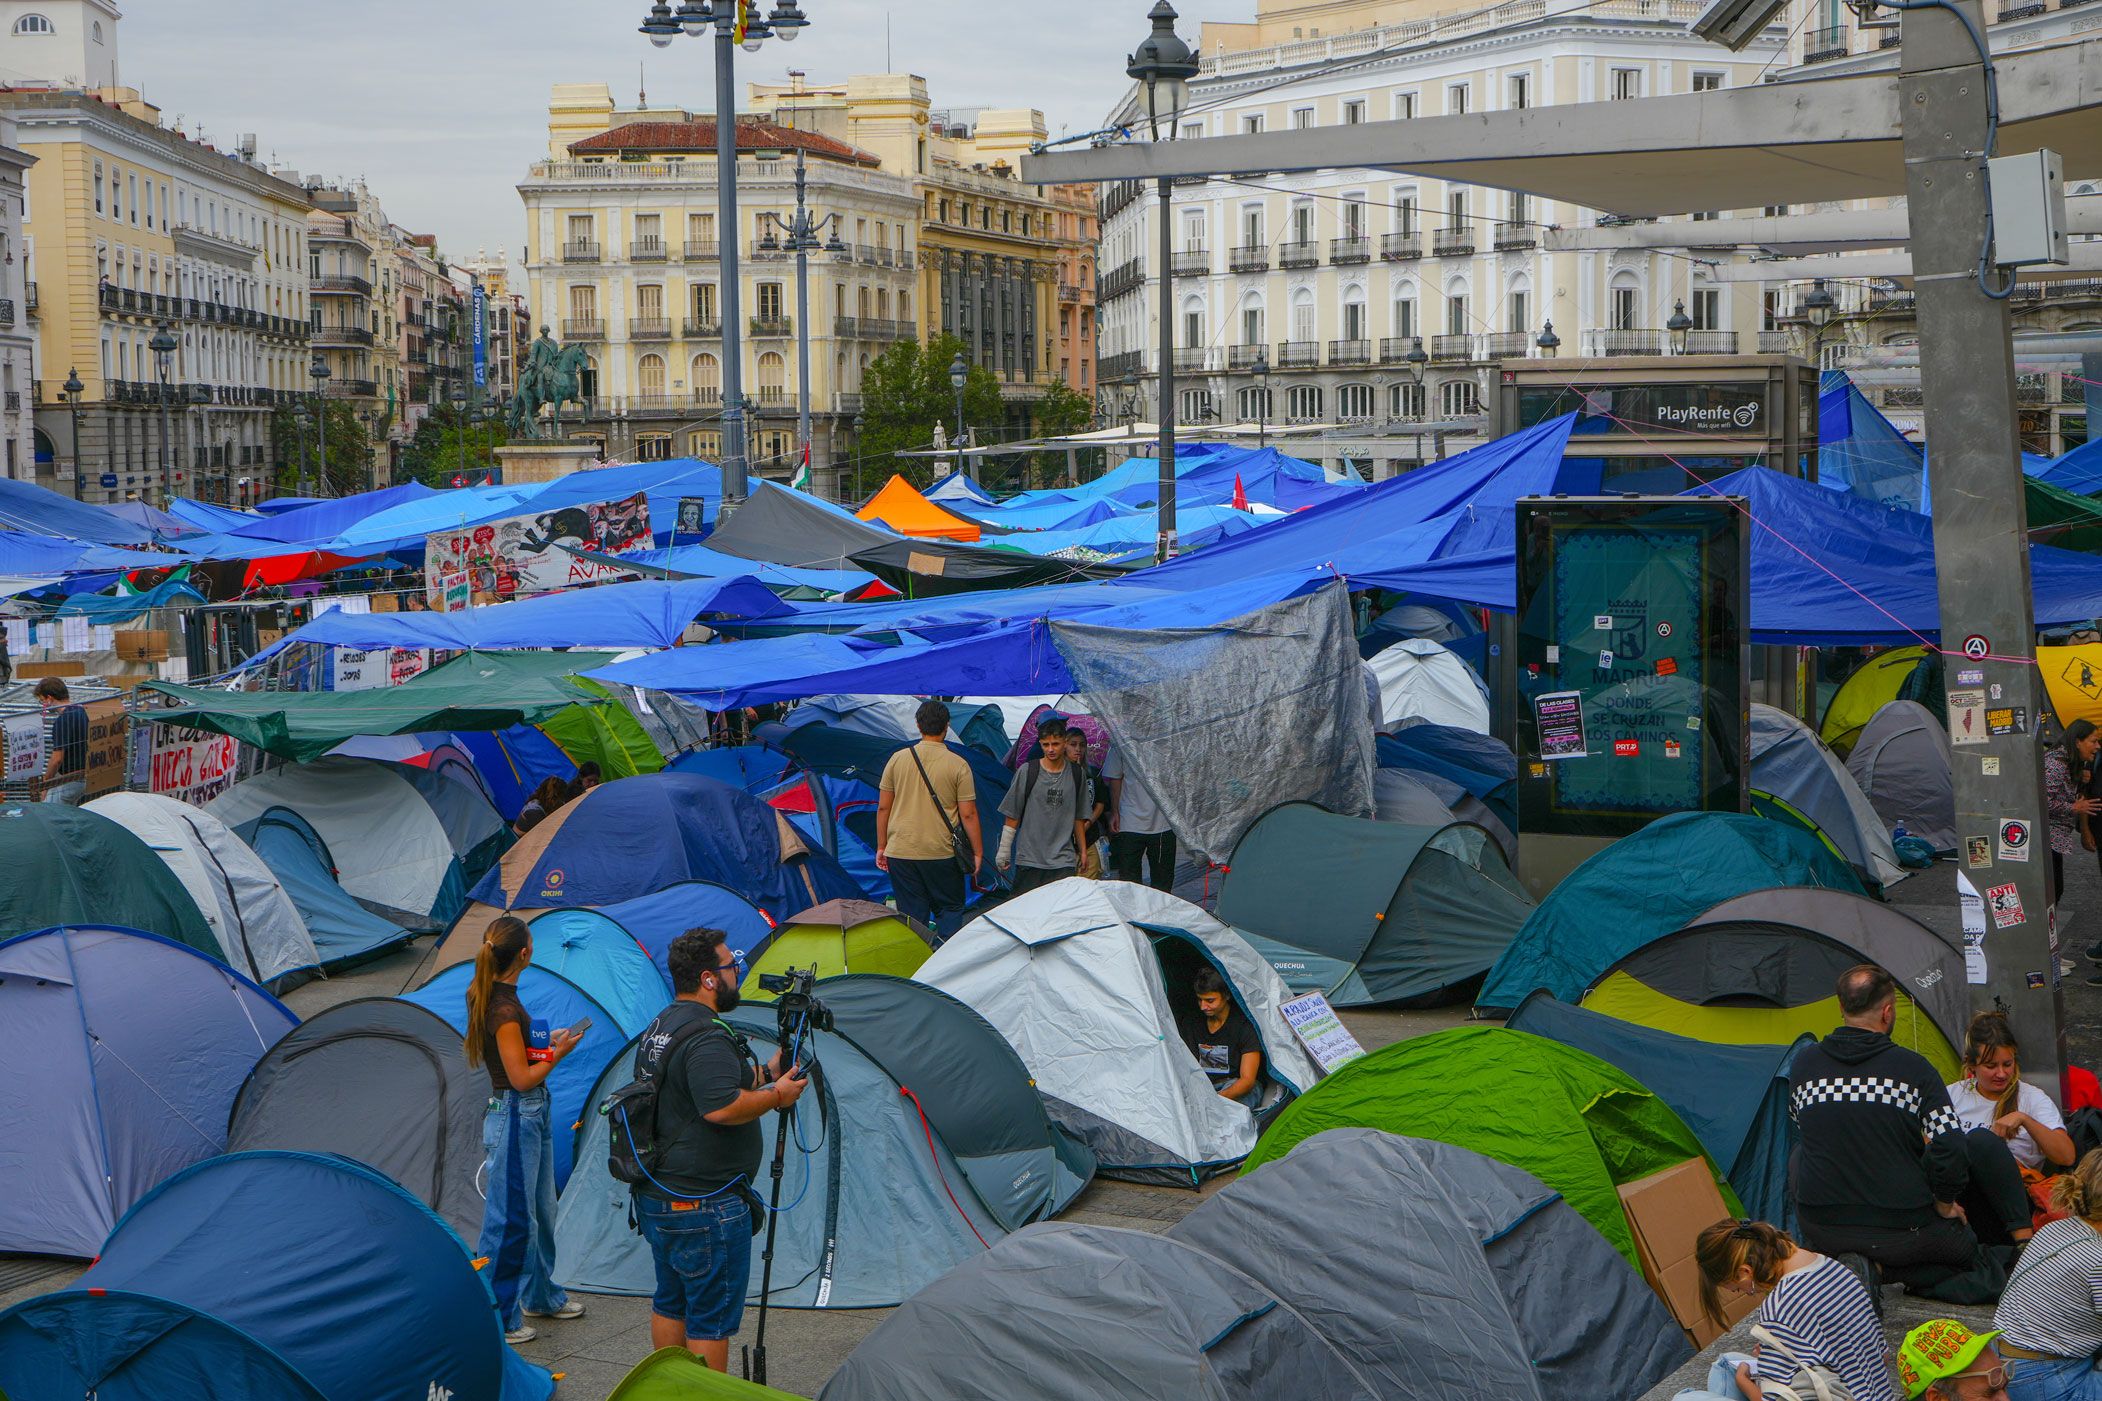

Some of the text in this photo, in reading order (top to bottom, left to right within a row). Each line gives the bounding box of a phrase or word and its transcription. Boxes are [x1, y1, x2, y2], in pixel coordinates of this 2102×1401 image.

[1658, 405, 1731, 423] PlayRenfe
[476, 528, 492, 538] STOP
[1606, 696, 1652, 709] DONDE
[1593, 713, 1608, 725] SE
[1612, 713, 1665, 728] CRUZAN
[1587, 729, 1676, 743] LOS CAMINOS
[1990, 885, 2015, 898] ANTI
[1274, 962, 1305, 970] QUECHUA
[532, 1030, 547, 1039] tve
[825, 1252, 833, 1273] SECONDS
